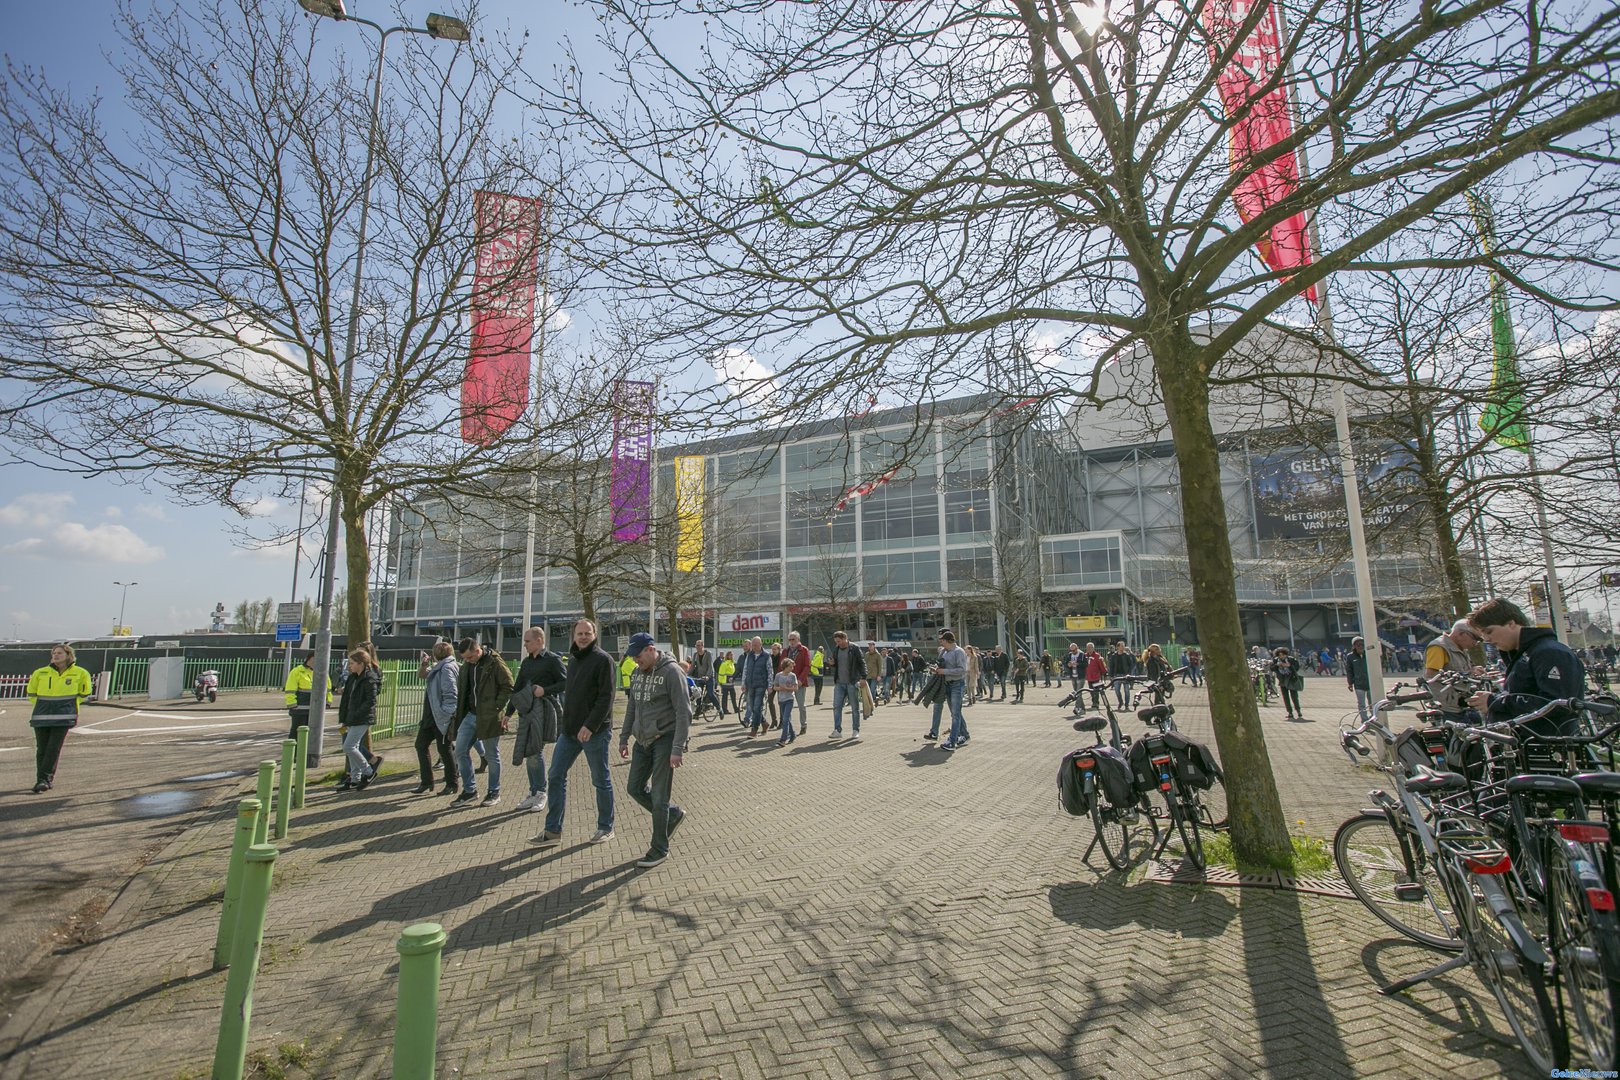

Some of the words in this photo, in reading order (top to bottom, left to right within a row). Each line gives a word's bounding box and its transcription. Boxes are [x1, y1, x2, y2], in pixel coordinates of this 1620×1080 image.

[1290, 454, 1389, 474] GELREOME
[1284, 512, 1303, 522] HET
[1302, 521, 1324, 530] VAN
[1327, 515, 1392, 529] NEDLAND
[916, 600, 935, 609] dam
[732, 614, 764, 632] dam
